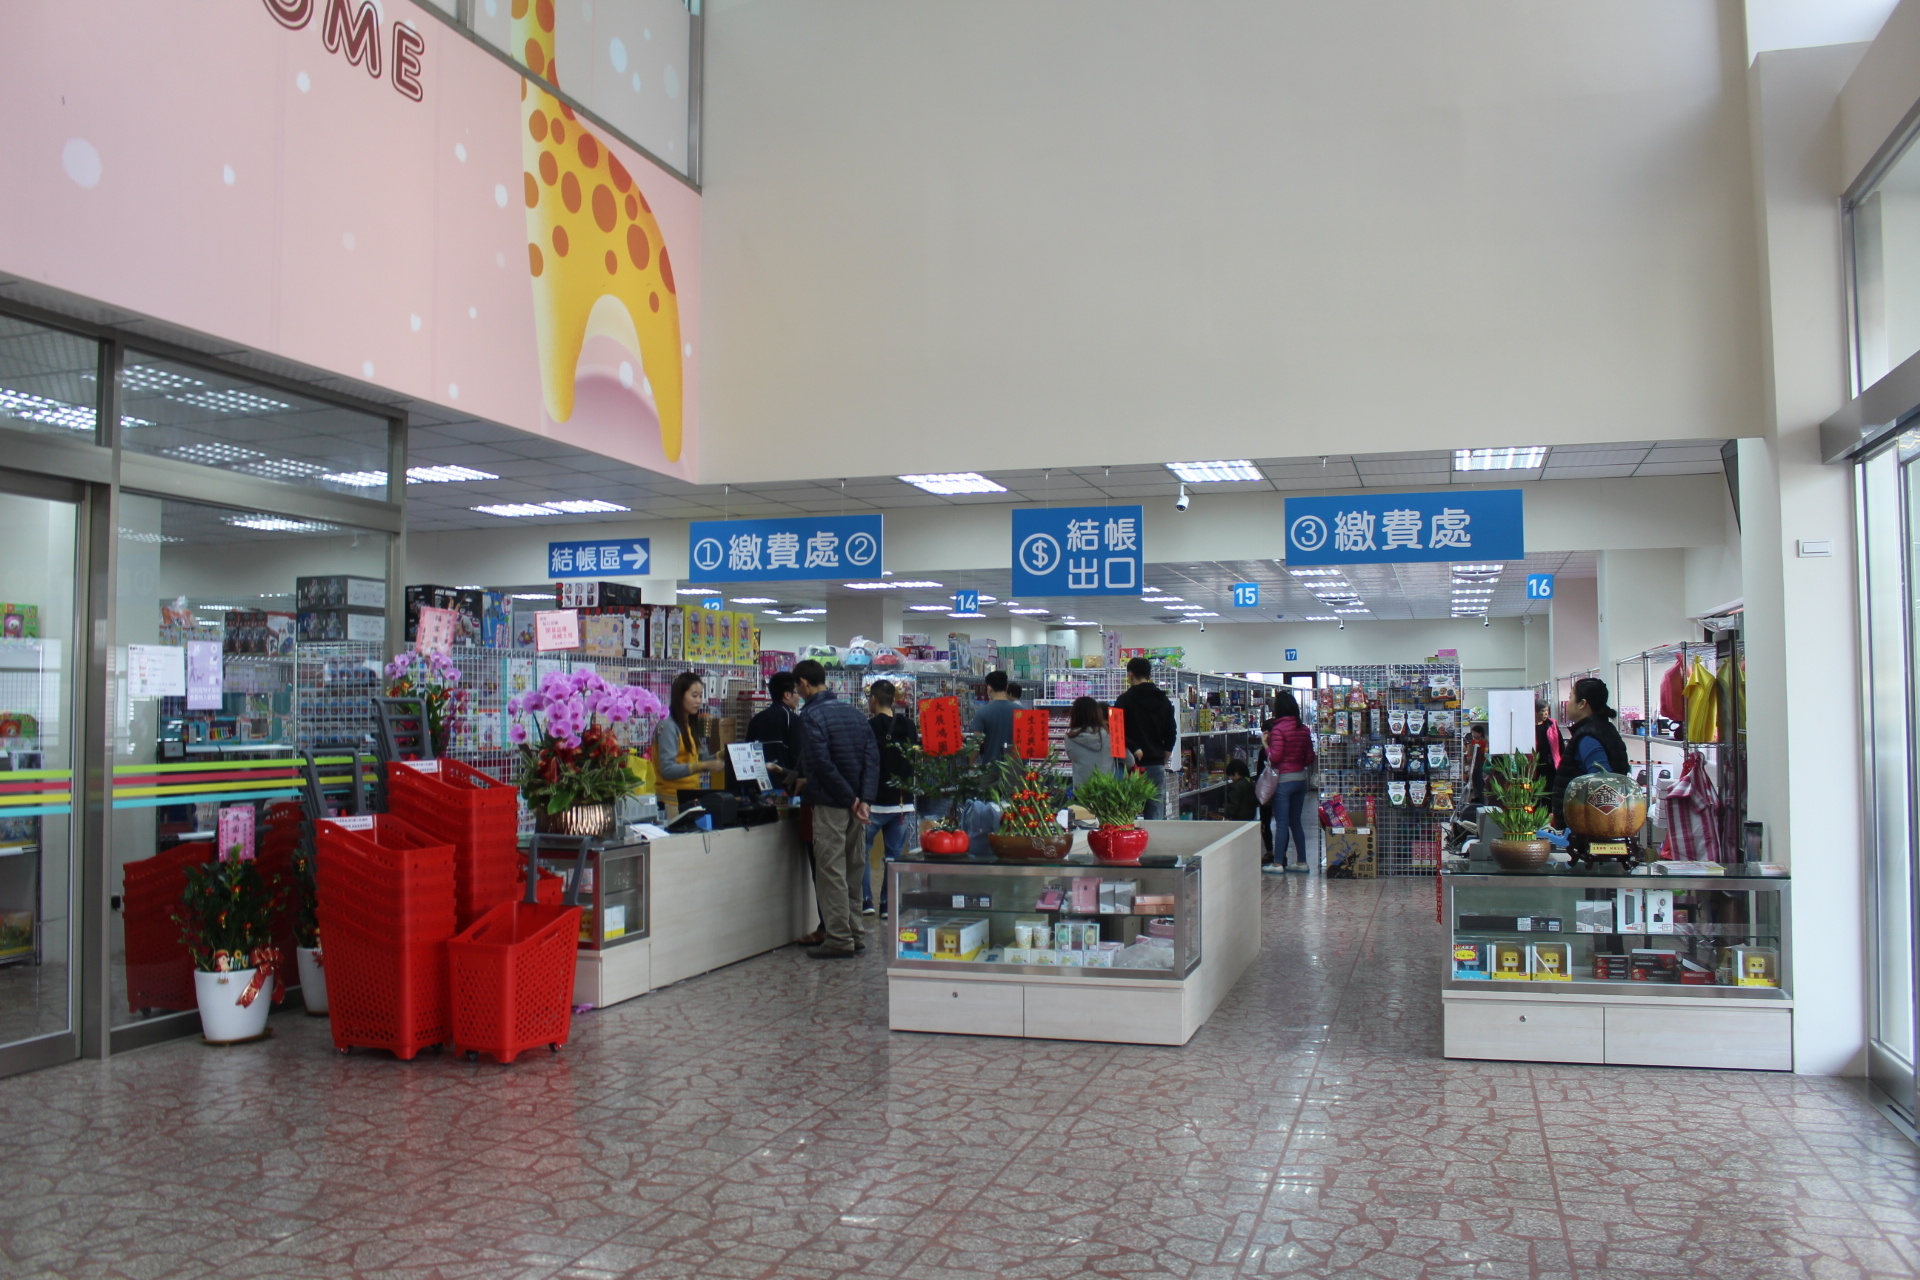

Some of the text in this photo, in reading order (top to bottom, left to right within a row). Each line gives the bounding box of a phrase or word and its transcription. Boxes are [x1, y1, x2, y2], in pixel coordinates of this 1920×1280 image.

[1067, 518, 1137, 552] 結帳
[551, 546, 621, 573] 結帳區
[1068, 557, 1136, 589] 出口
[1235, 587, 1256, 605] 15
[1528, 578, 1551, 597] 16
[957, 594, 977, 611] 14
[1286, 651, 1297, 660] 17
